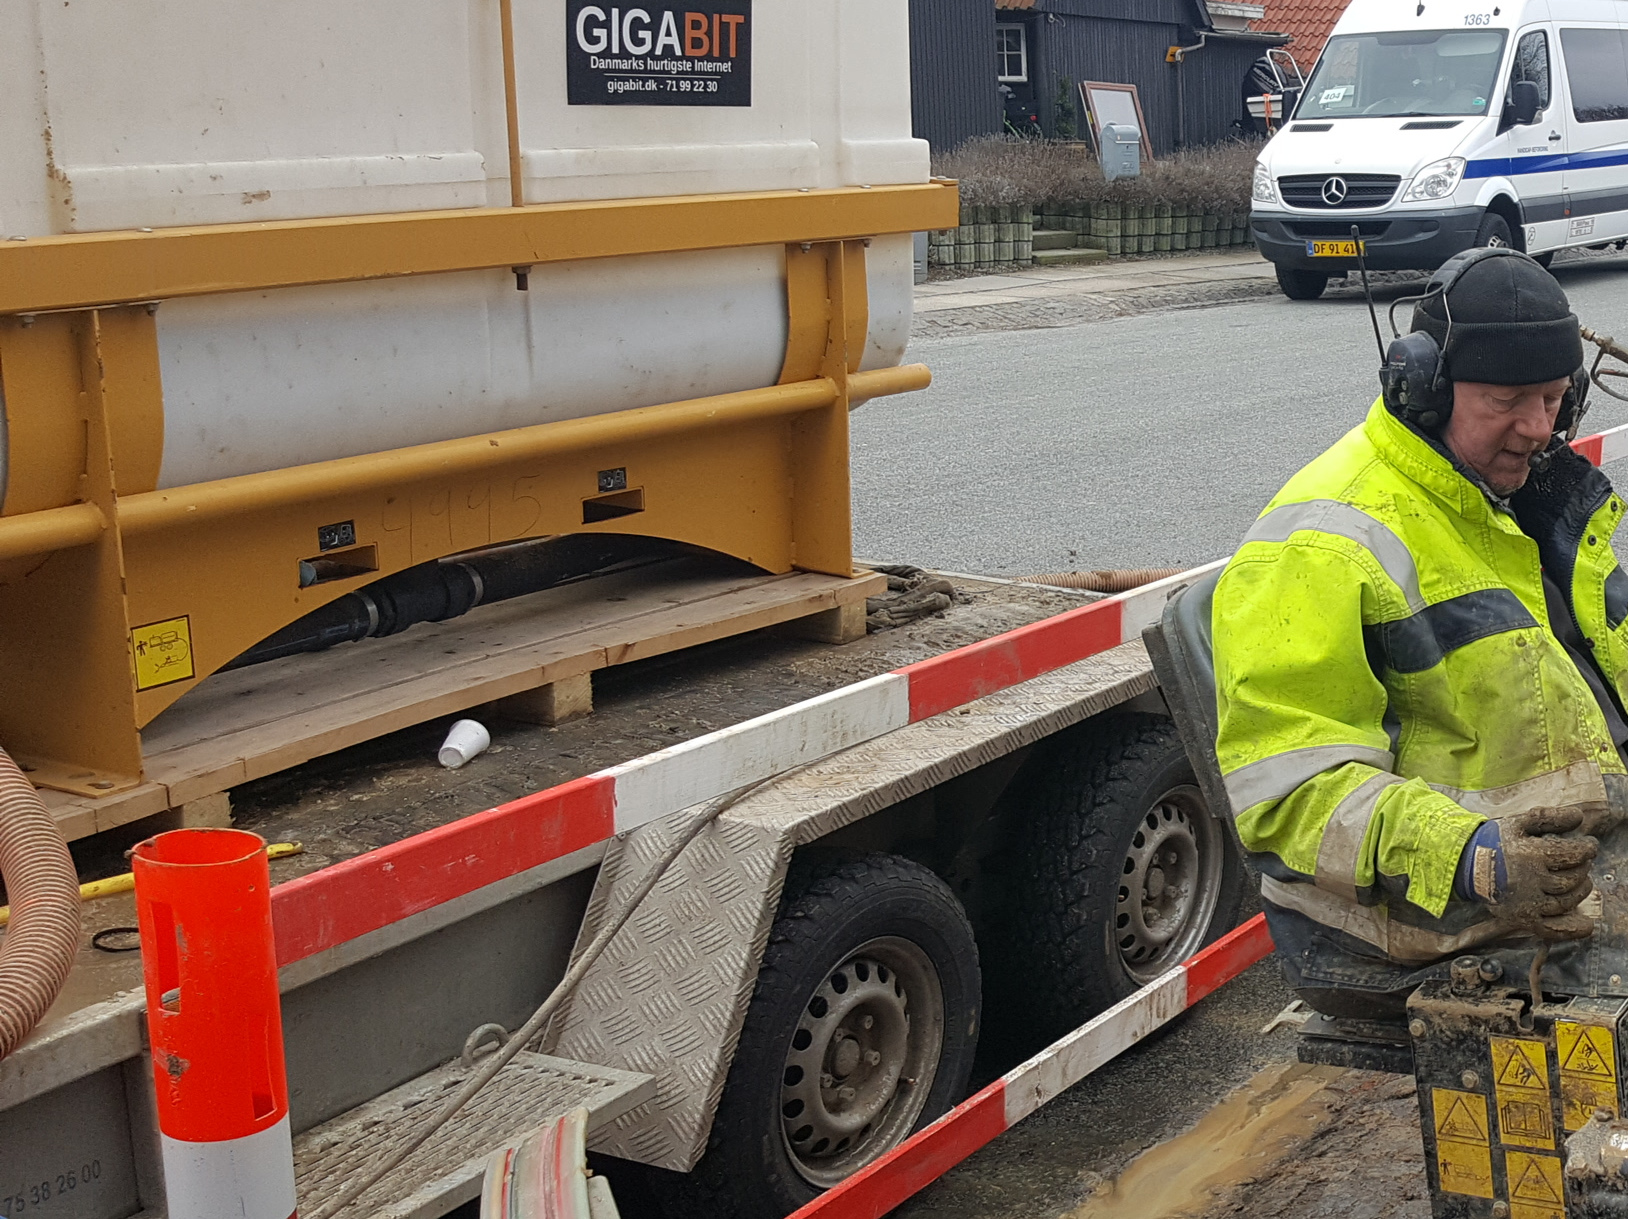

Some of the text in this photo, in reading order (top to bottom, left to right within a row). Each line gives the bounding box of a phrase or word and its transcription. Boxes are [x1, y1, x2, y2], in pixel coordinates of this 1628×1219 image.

[1463, 14, 1491, 26] 1363
[575, 5, 746, 58] GIGABIT
[590, 55, 733, 75] Danmarks hurtigste Internet
[607, 78, 658, 94] gigabit.dk
[665, 80, 678, 92] 71
[679, 80, 691, 92] 99
[692, 80, 705, 92] 22
[706, 81, 718, 92] 30
[1252, 67, 1280, 87] MERCURY
[1323, 92, 1342, 101] 404
[1313, 243, 1327, 254] DF
[1328, 243, 1340, 254] 91
[30, 1181, 52, 1206] 38
[55, 1169, 77, 1195] 26
[82, 1159, 101, 1184] 00
